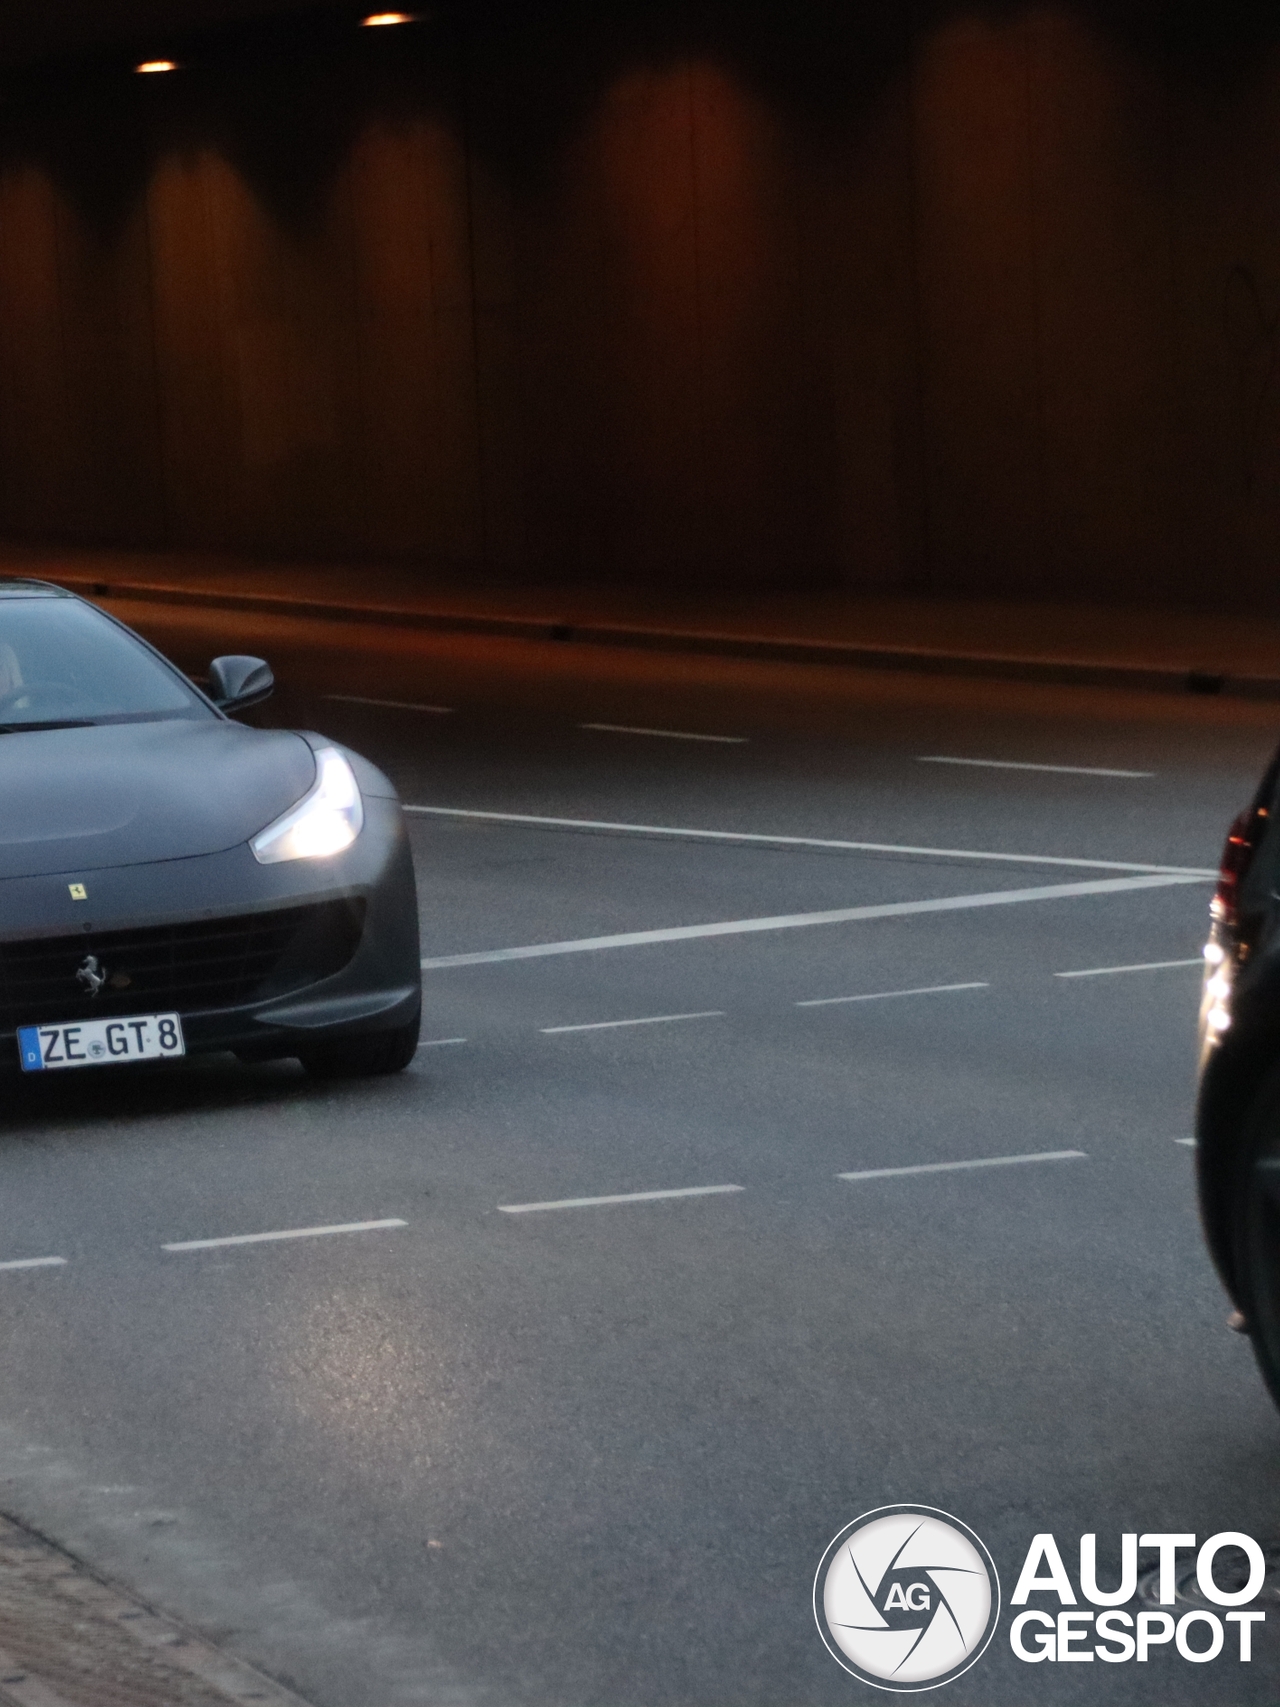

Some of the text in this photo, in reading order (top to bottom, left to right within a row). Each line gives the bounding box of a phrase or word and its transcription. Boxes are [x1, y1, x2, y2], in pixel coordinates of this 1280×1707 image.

[40, 1018, 178, 1063] ZE GT 8
[28, 1052, 36, 1062] D
